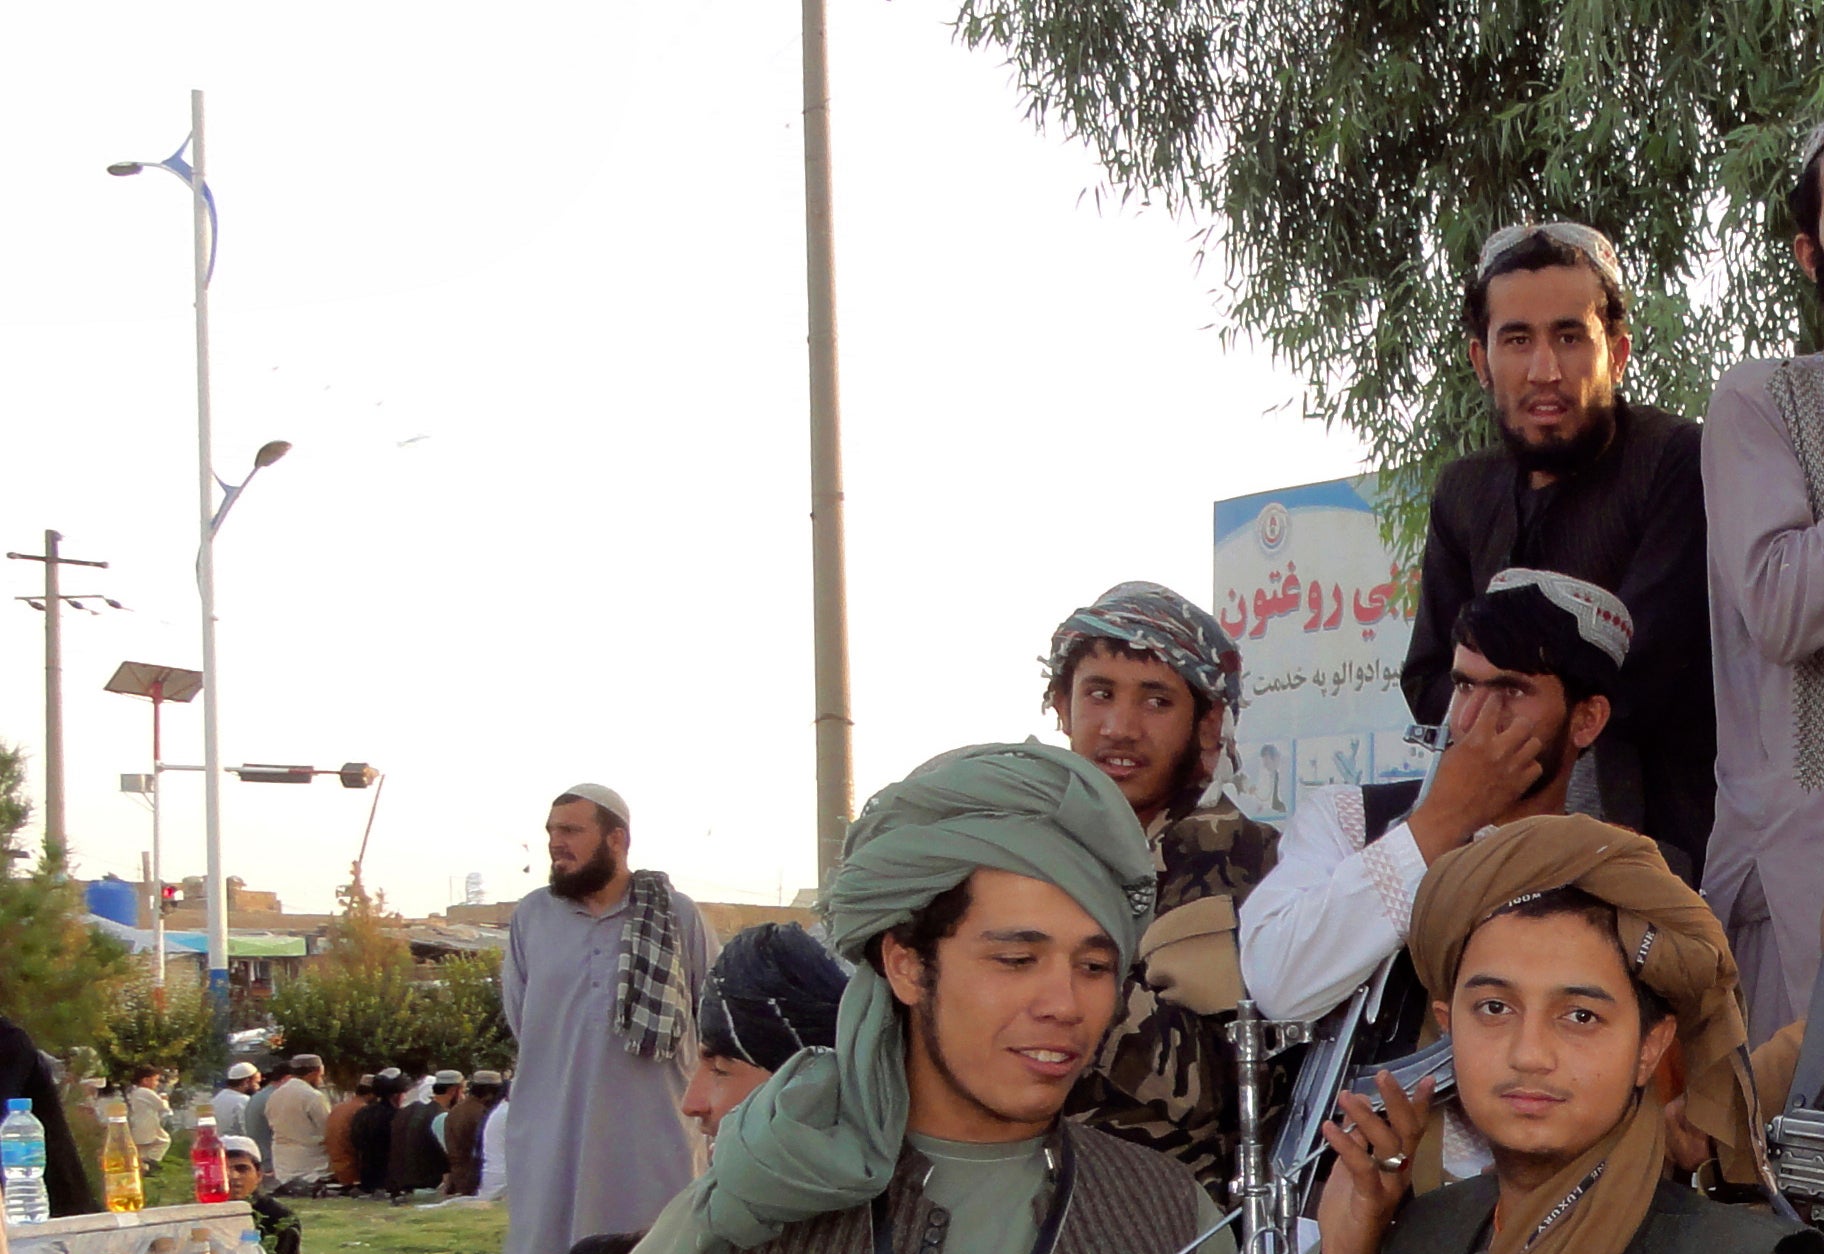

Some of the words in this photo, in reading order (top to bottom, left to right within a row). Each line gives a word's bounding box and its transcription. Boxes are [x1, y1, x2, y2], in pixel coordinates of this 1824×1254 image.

[1220, 560, 1344, 640] روغتون
[1252, 667, 1307, 696] خدمت
[1537, 1186, 1584, 1233] LUXURY
